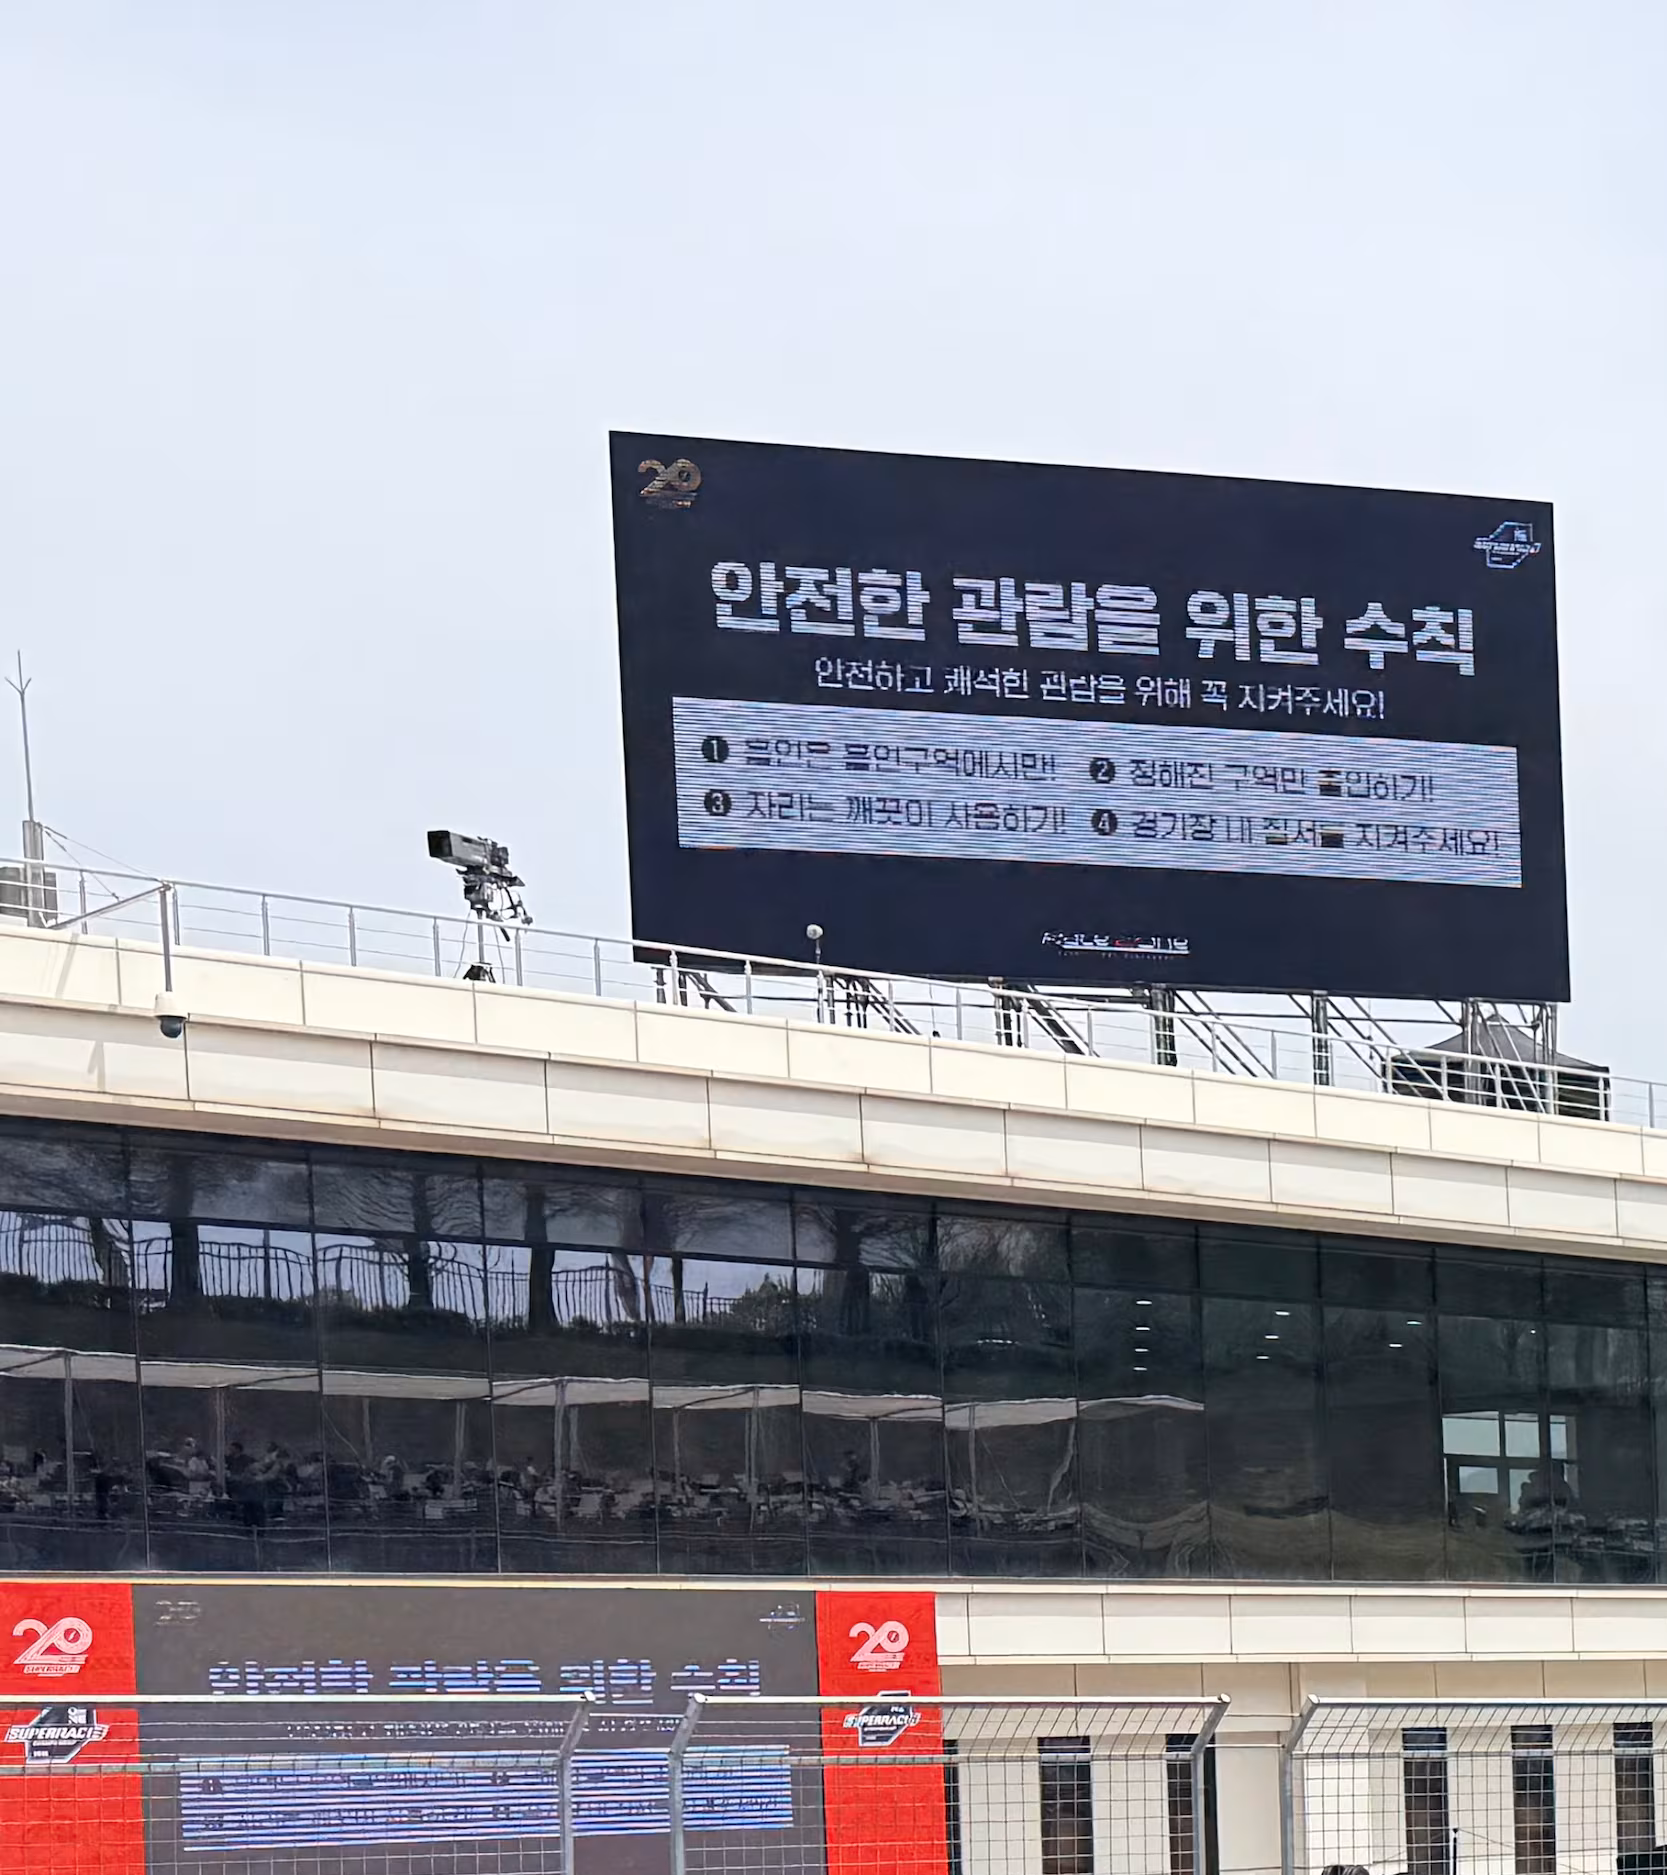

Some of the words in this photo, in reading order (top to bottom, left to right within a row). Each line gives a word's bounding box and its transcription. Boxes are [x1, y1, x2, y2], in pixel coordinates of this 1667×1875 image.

[711, 561, 930, 641] 안전한
[952, 575, 1160, 656] 관람을
[1186, 590, 1323, 666] 위한
[1344, 601, 1475, 677] 수칙
[814, 655, 934, 694] 안전하고
[1136, 676, 1191, 708] 위해
[1201, 679, 1228, 711] 꼭
[1238, 683, 1386, 720] 지켜주세요!
